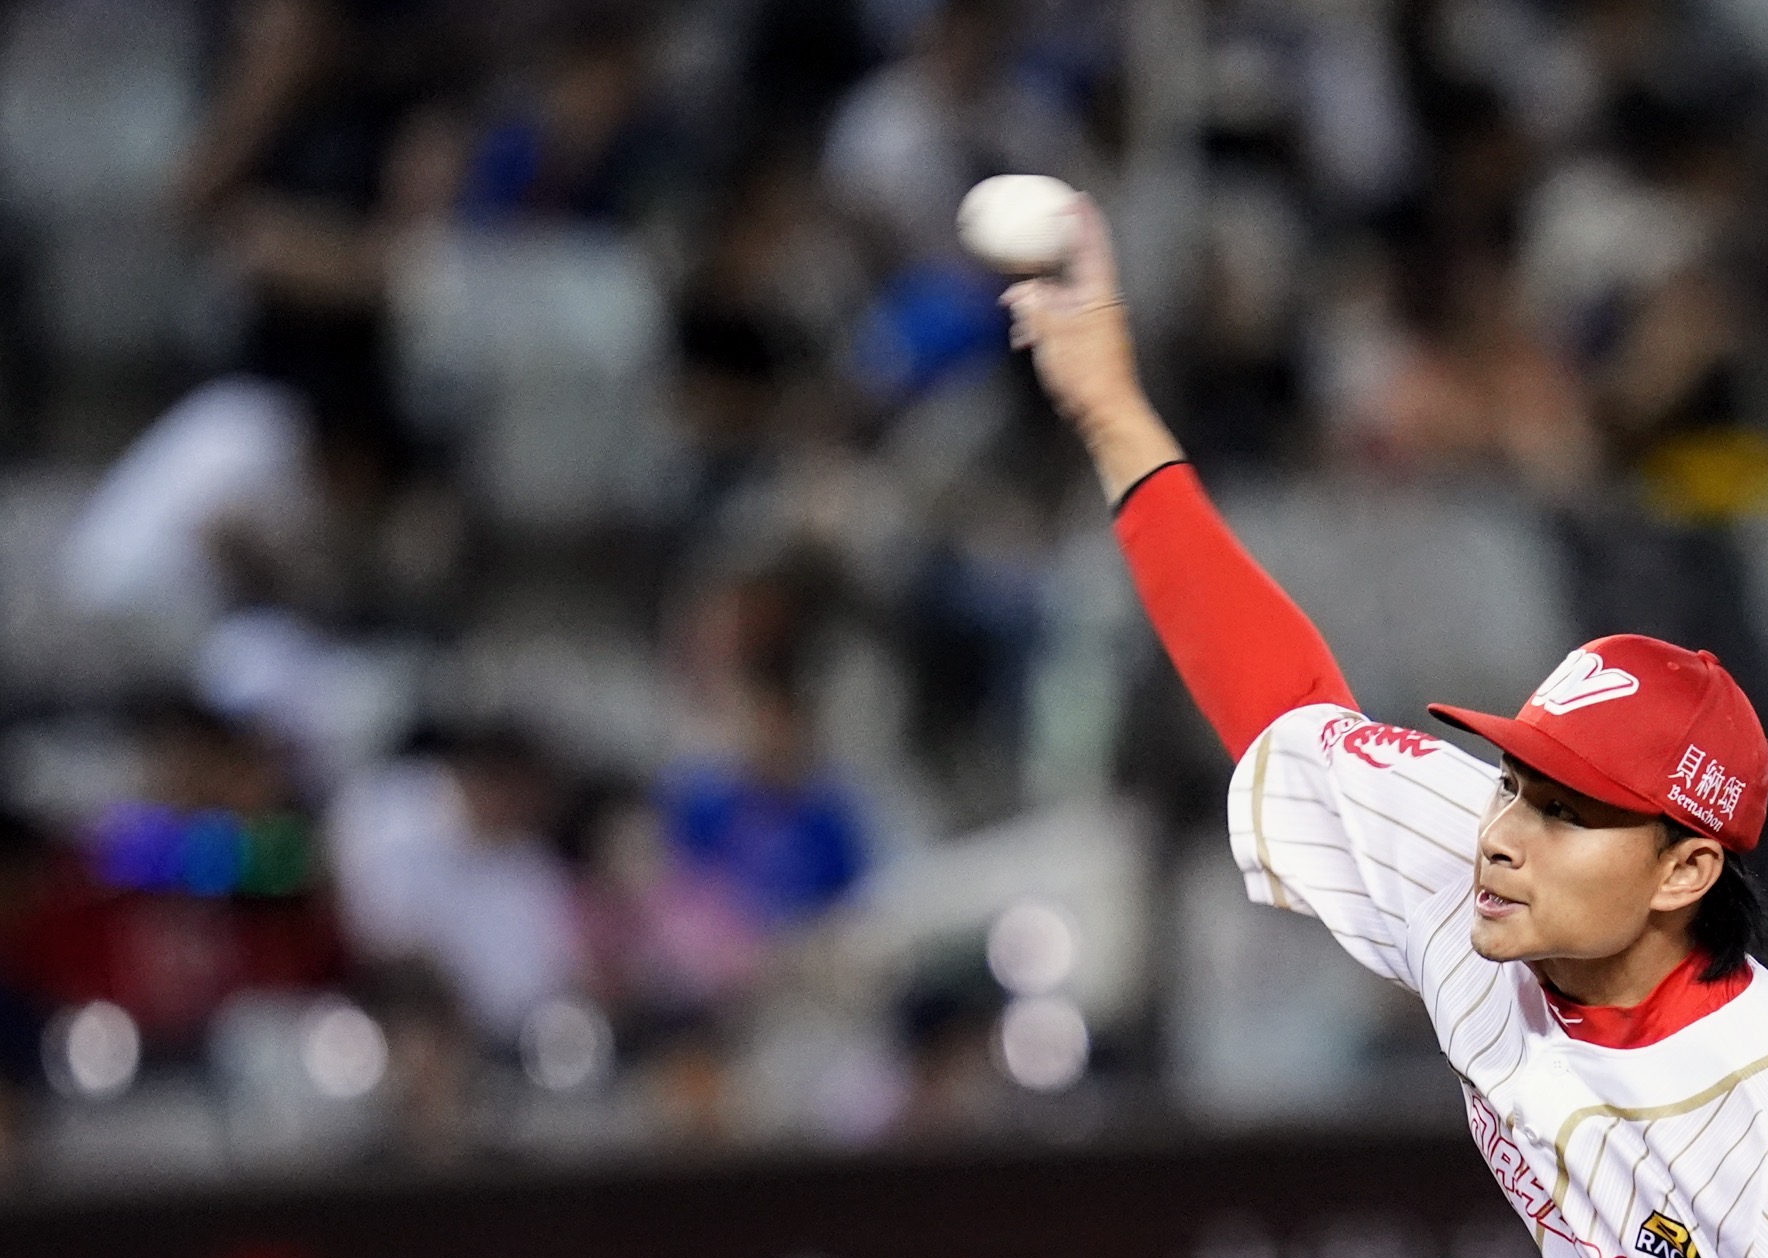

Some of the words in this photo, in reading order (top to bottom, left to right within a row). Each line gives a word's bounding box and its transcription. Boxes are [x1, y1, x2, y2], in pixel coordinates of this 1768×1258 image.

[1666, 783, 1724, 832] Bernachon
[1668, 743, 1747, 821] 貝納頌
